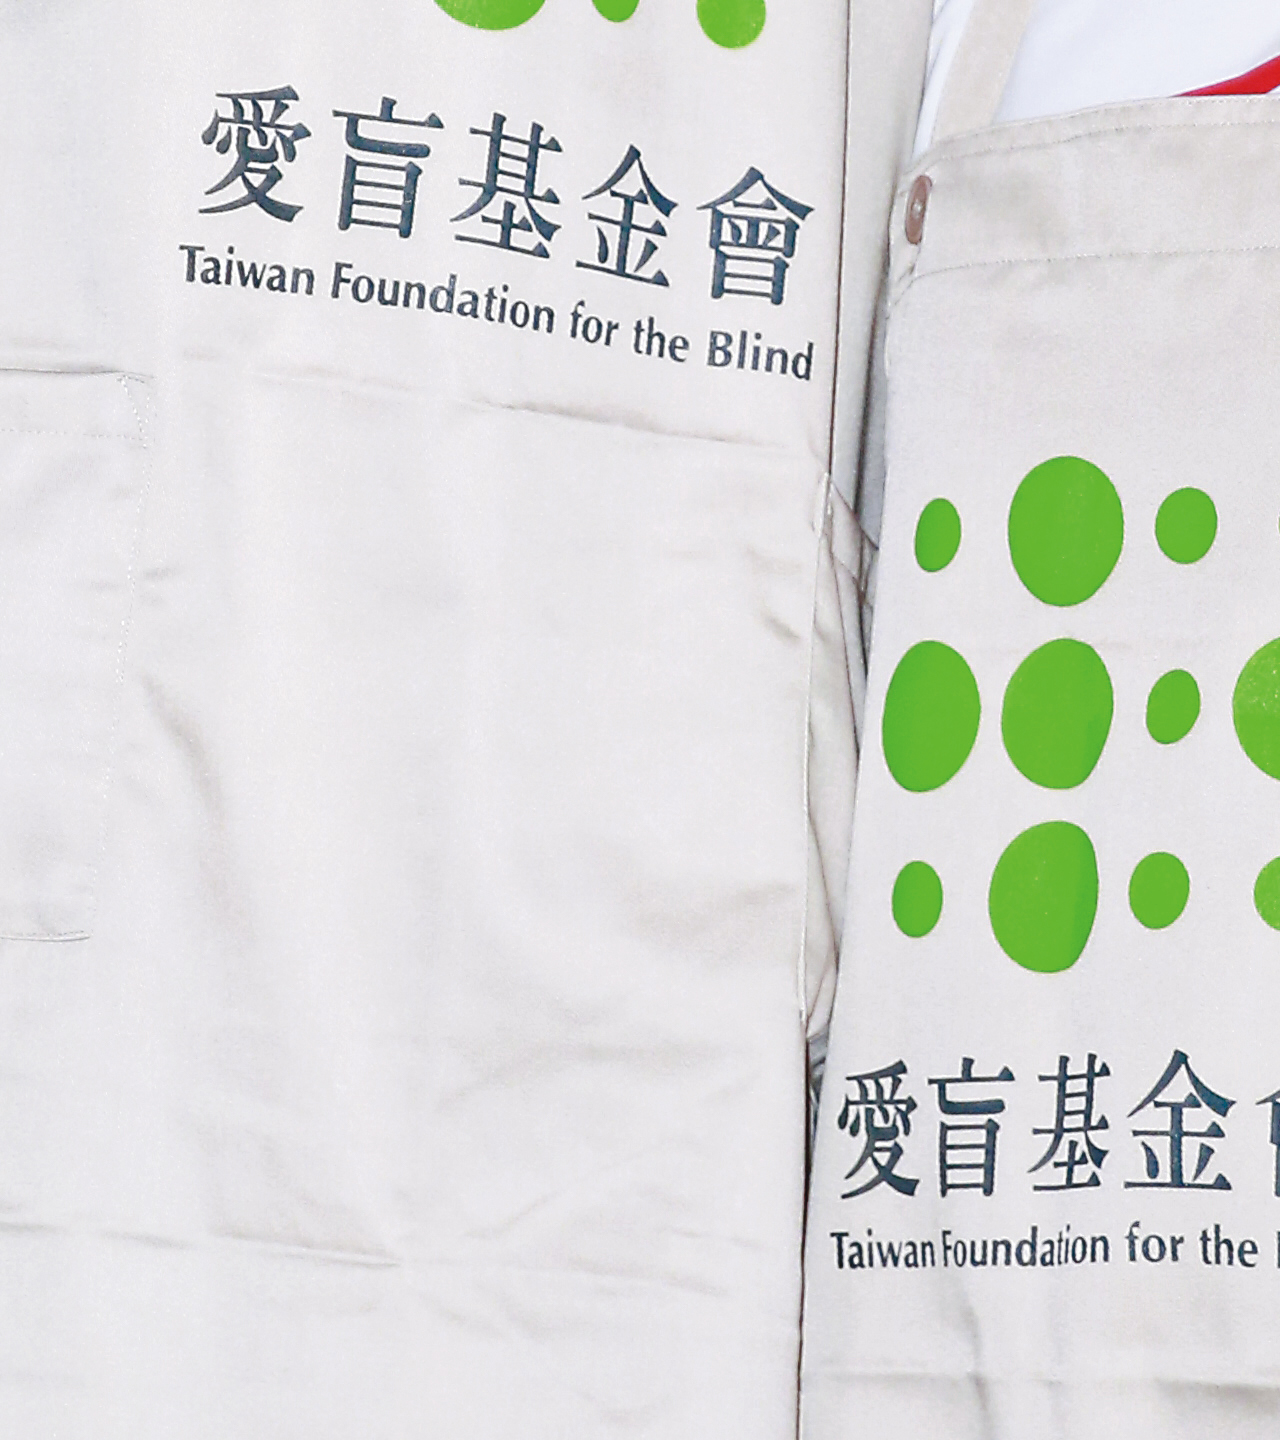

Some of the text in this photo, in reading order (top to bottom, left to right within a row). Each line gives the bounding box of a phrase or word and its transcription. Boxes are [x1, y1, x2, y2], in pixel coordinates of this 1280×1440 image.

[198, 84, 816, 307] 愛盲基金會
[179, 243, 815, 382] Taiwan Foundation for the Blind
[830, 1229, 936, 1270] Taiwan
[942, 1224, 1111, 1270] Foundation
[1124, 1221, 1185, 1265] for
[1198, 1224, 1259, 1269] the
